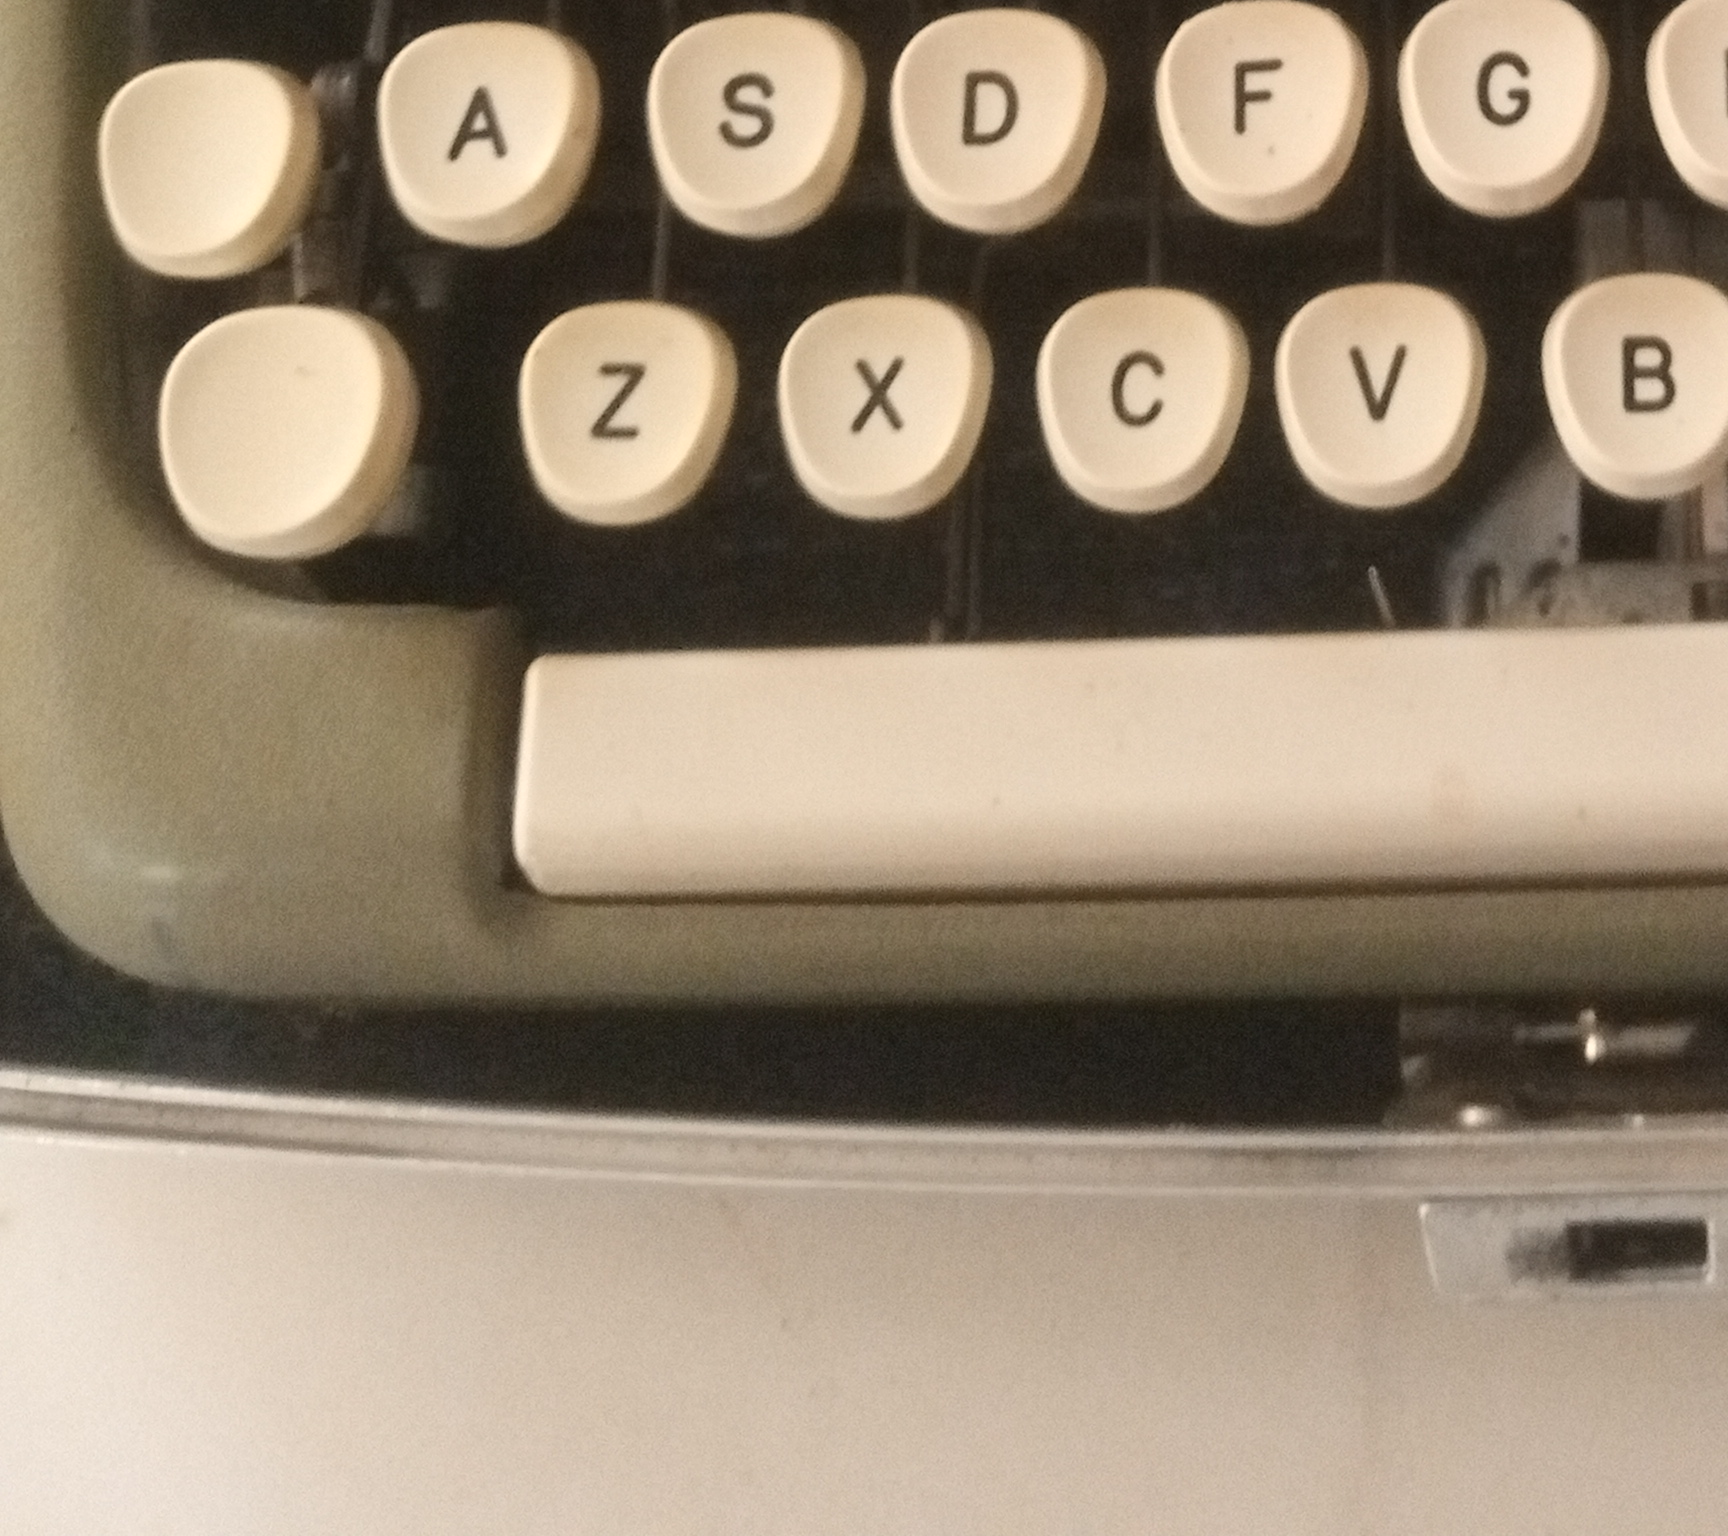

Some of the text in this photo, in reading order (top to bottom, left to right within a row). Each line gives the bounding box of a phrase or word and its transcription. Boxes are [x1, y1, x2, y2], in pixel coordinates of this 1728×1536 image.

[446, 85, 509, 163] A
[717, 71, 776, 151] S
[960, 69, 1021, 148] D
[1233, 57, 1285, 136] F
[1475, 49, 1532, 129] G
[589, 361, 647, 441] Z
[849, 356, 905, 435] X
[1109, 349, 1166, 429] C
[1348, 343, 1409, 424] V
[1620, 334, 1678, 415] B
